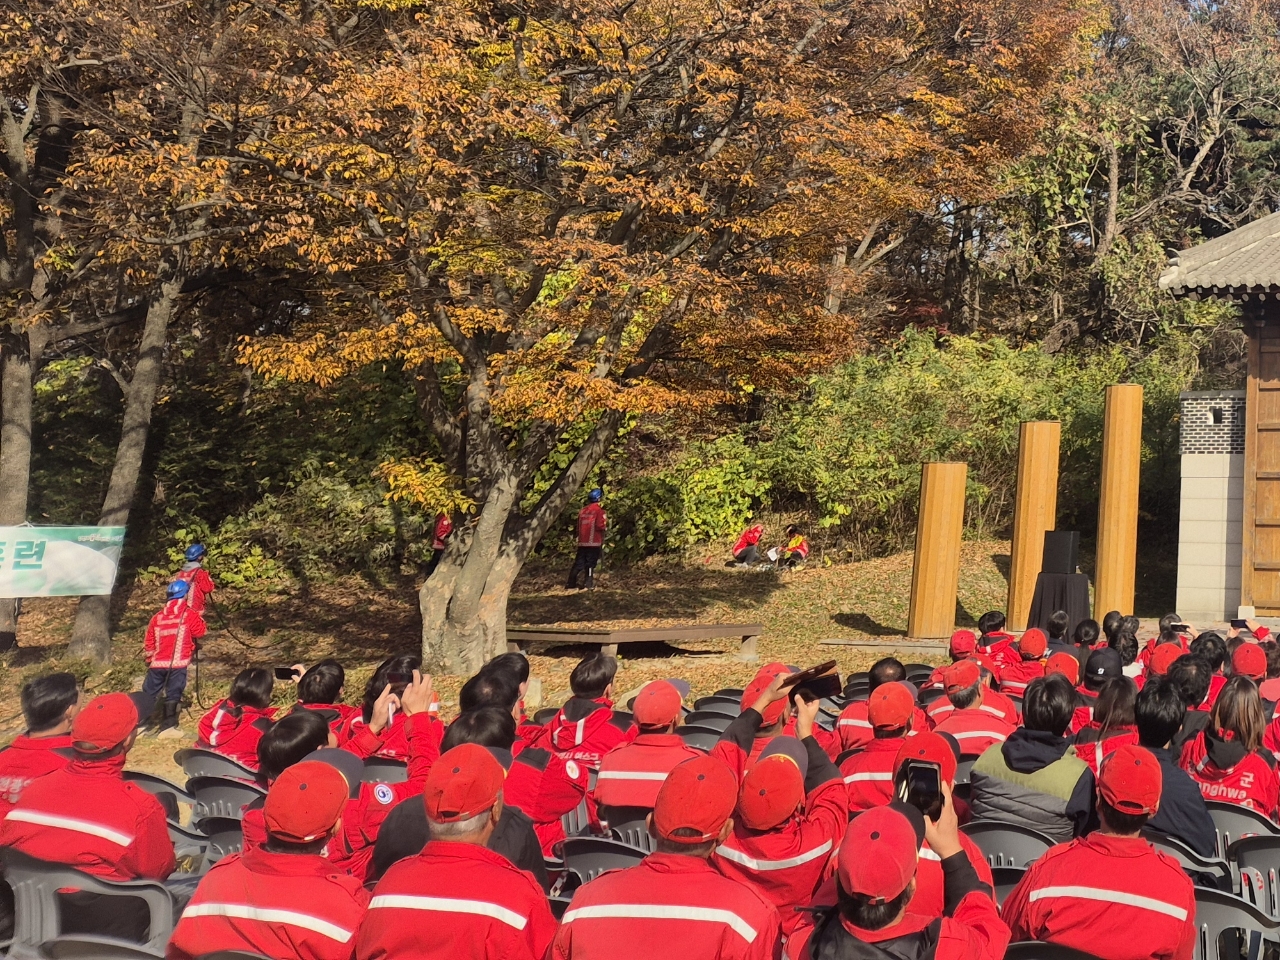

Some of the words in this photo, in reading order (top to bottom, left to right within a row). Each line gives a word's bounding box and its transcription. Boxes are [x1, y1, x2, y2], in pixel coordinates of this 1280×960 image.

[0, 540, 47, 571] 련
[1240, 771, 1254, 788] 군
[1199, 781, 1247, 800] nghwa
